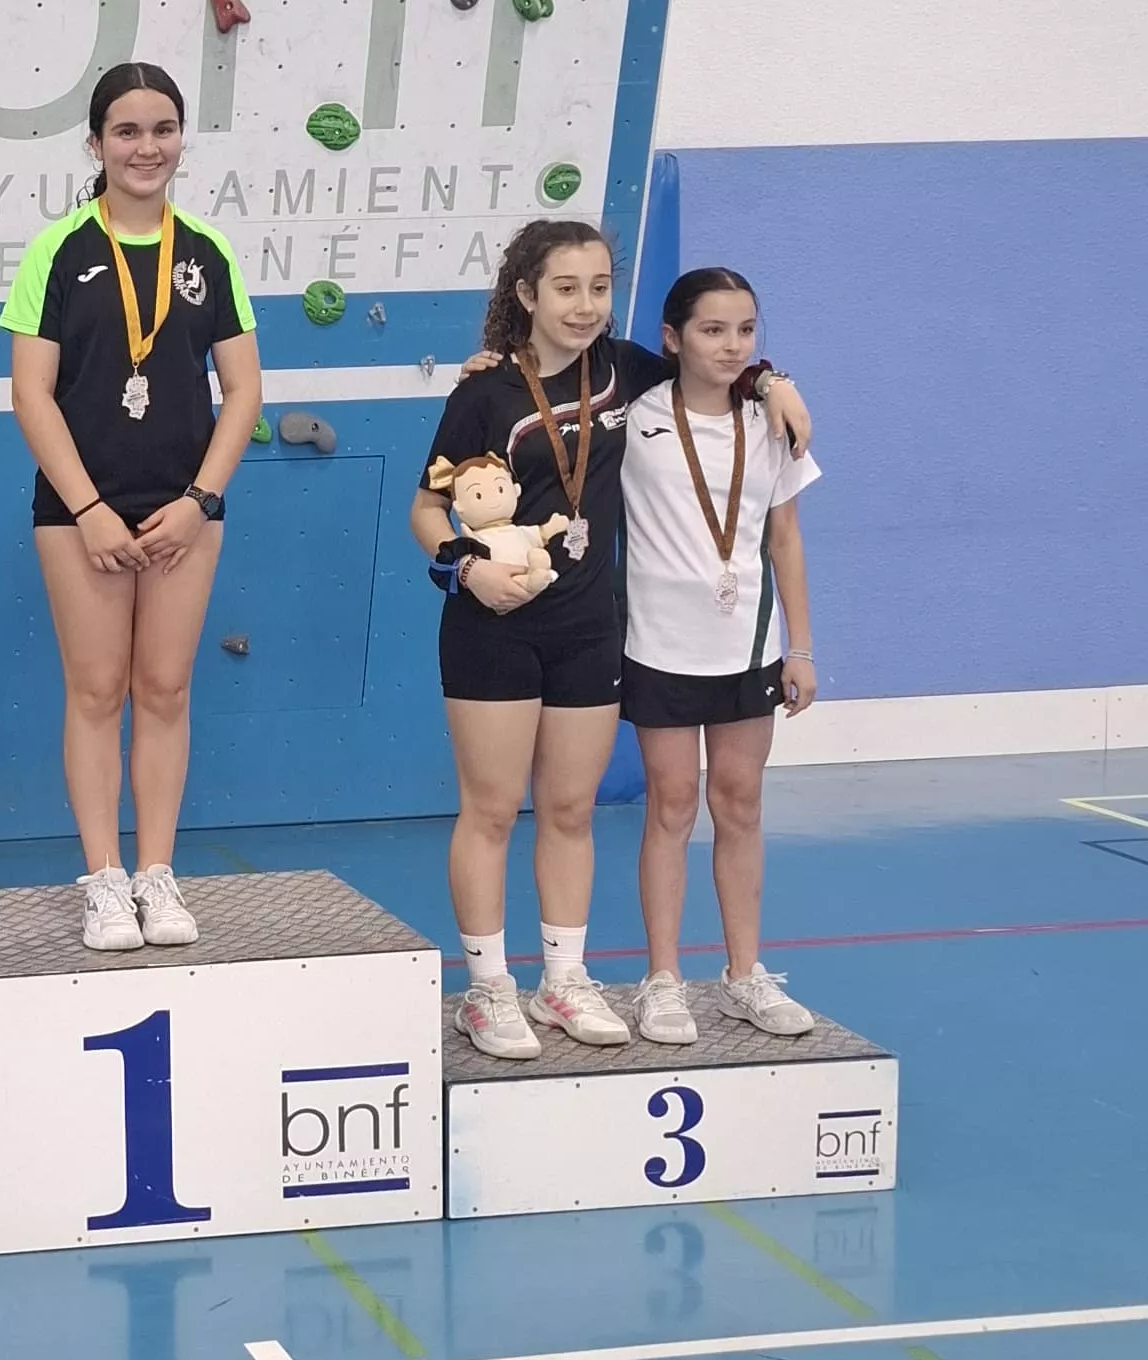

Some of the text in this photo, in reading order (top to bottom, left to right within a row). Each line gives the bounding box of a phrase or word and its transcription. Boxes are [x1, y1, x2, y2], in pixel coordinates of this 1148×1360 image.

[260, 225, 492, 281] NÉFA
[83, 1009, 211, 1230] 1
[282, 1083, 409, 1157] bnf
[644, 1086, 706, 1188] 3
[816, 1120, 881, 1157] bnf
[282, 1174, 305, 1184] DE
[283, 1155, 410, 1172] AYUNTAMIENTO
